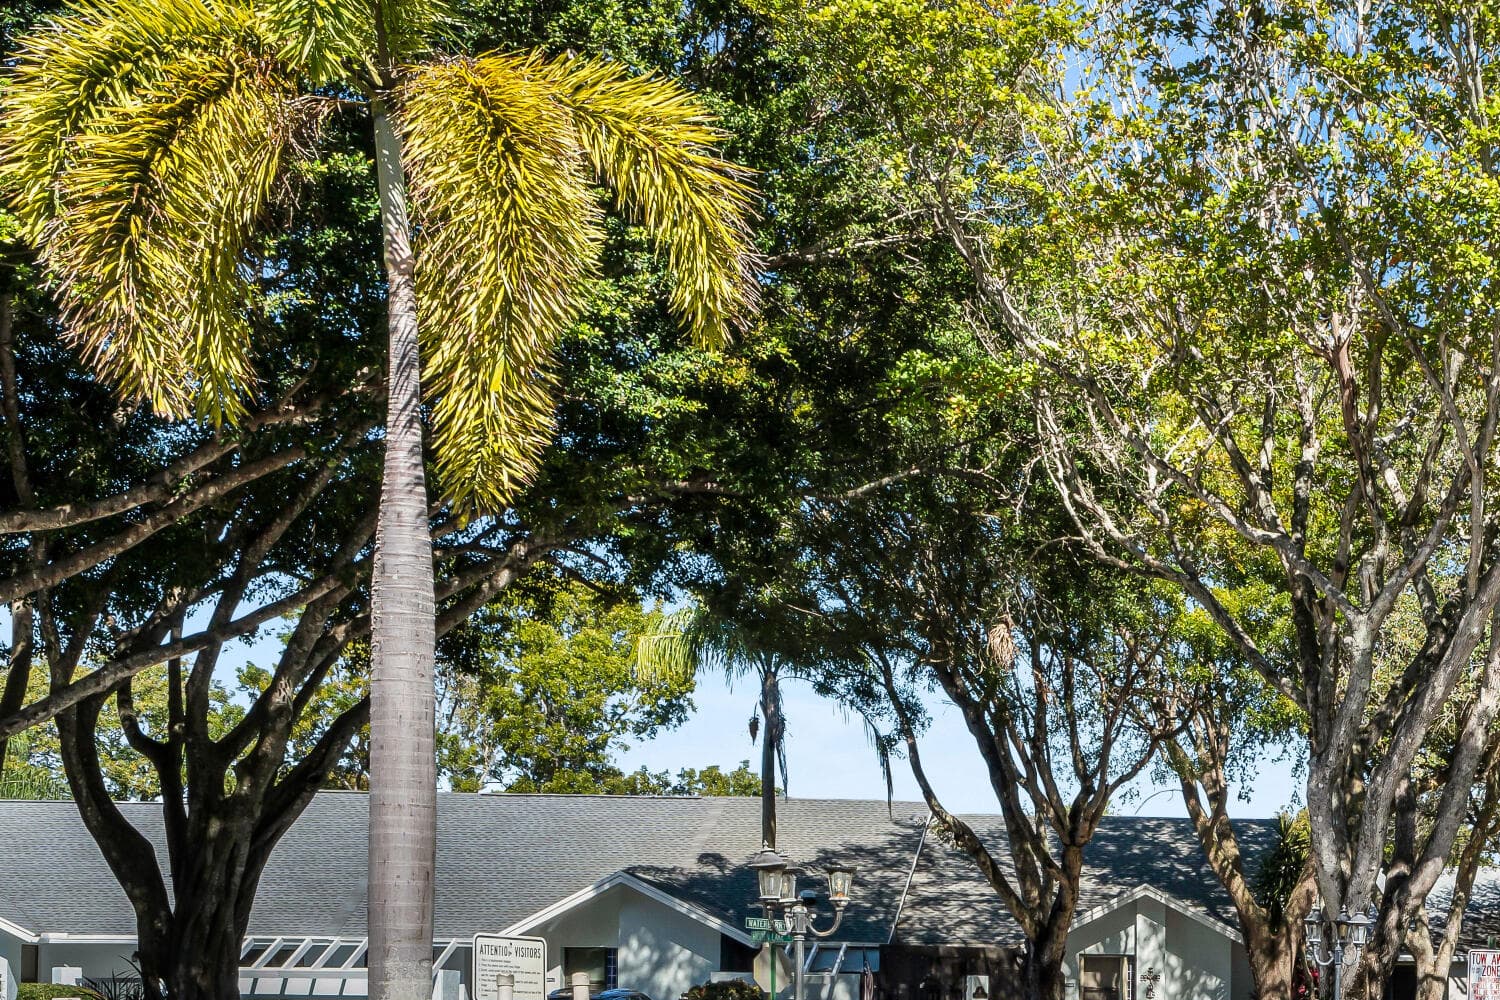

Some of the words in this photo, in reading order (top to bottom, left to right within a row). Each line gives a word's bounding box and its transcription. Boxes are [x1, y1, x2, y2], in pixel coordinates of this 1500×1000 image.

[515, 947, 541, 959] VISITORS
[1472, 953, 1487, 965] TOW
[1482, 966, 1500, 976] ZONE
